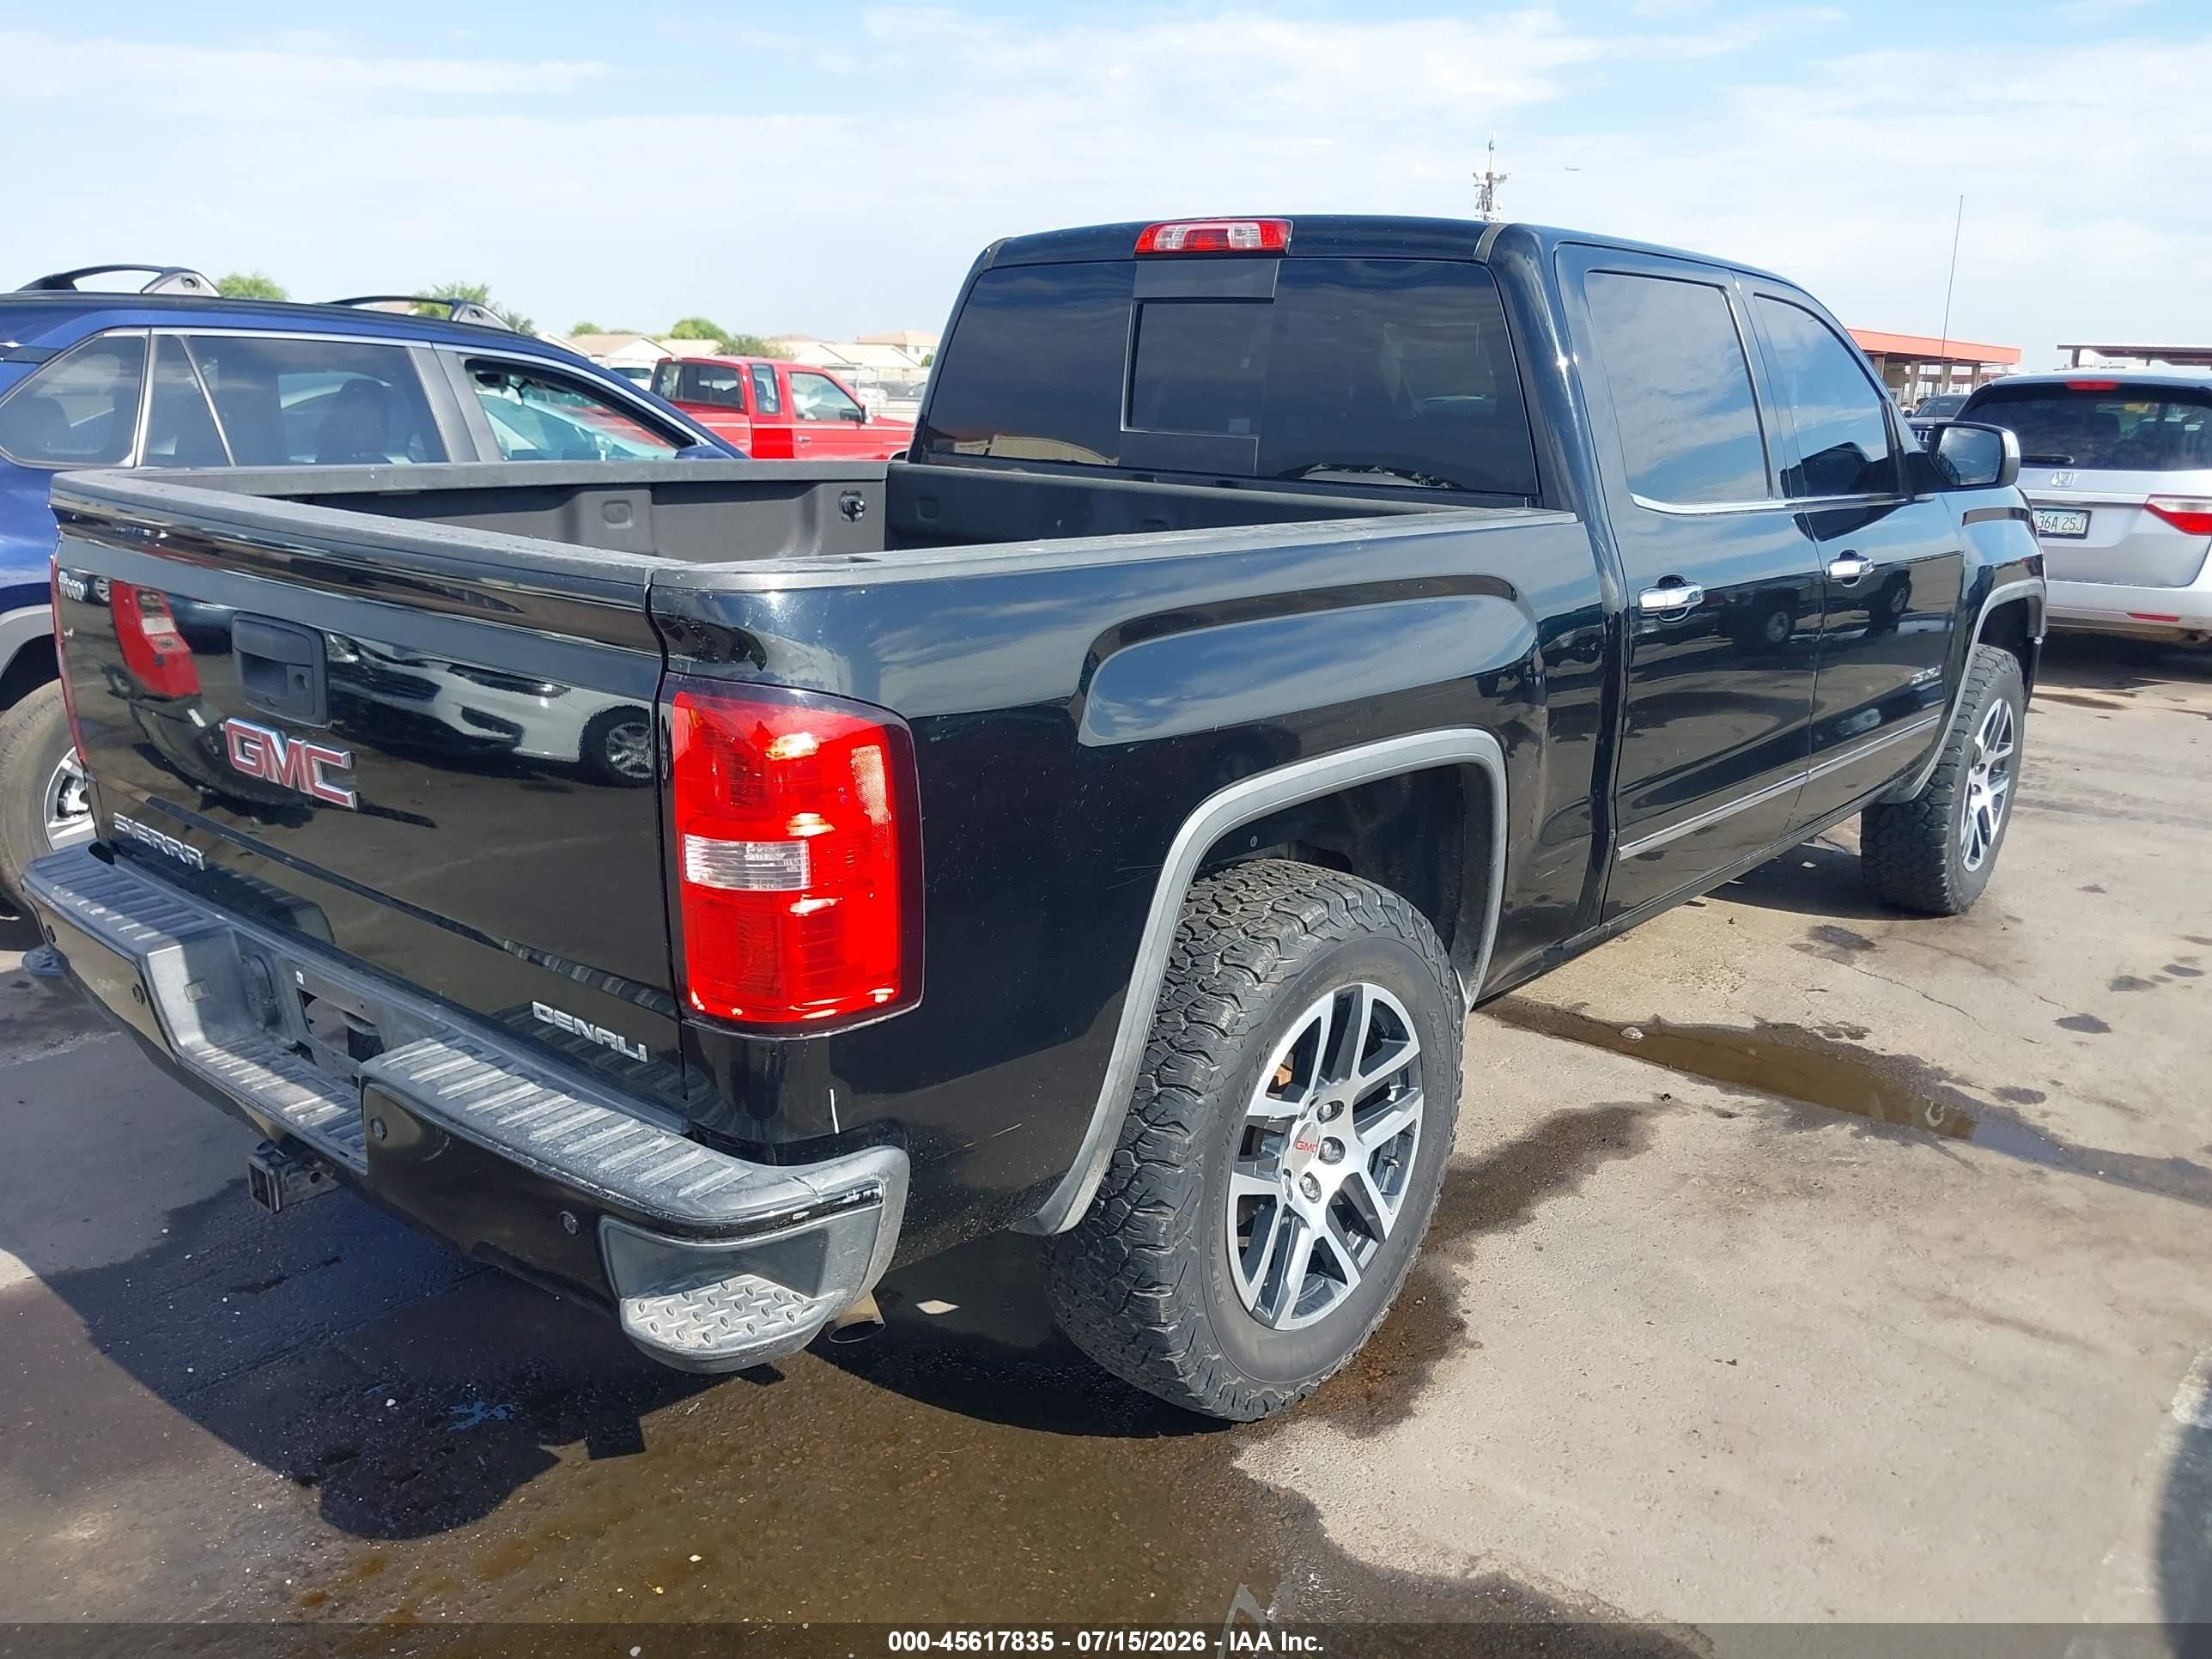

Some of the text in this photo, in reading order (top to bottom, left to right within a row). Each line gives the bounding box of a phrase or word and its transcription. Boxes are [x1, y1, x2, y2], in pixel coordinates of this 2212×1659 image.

[2061, 516, 2084, 532] 2SJ
[225, 717, 358, 811] GMC
[113, 811, 205, 872] SIERRA
[532, 1000, 648, 1063] DENALI
[1295, 1140, 1319, 1153] GMC
